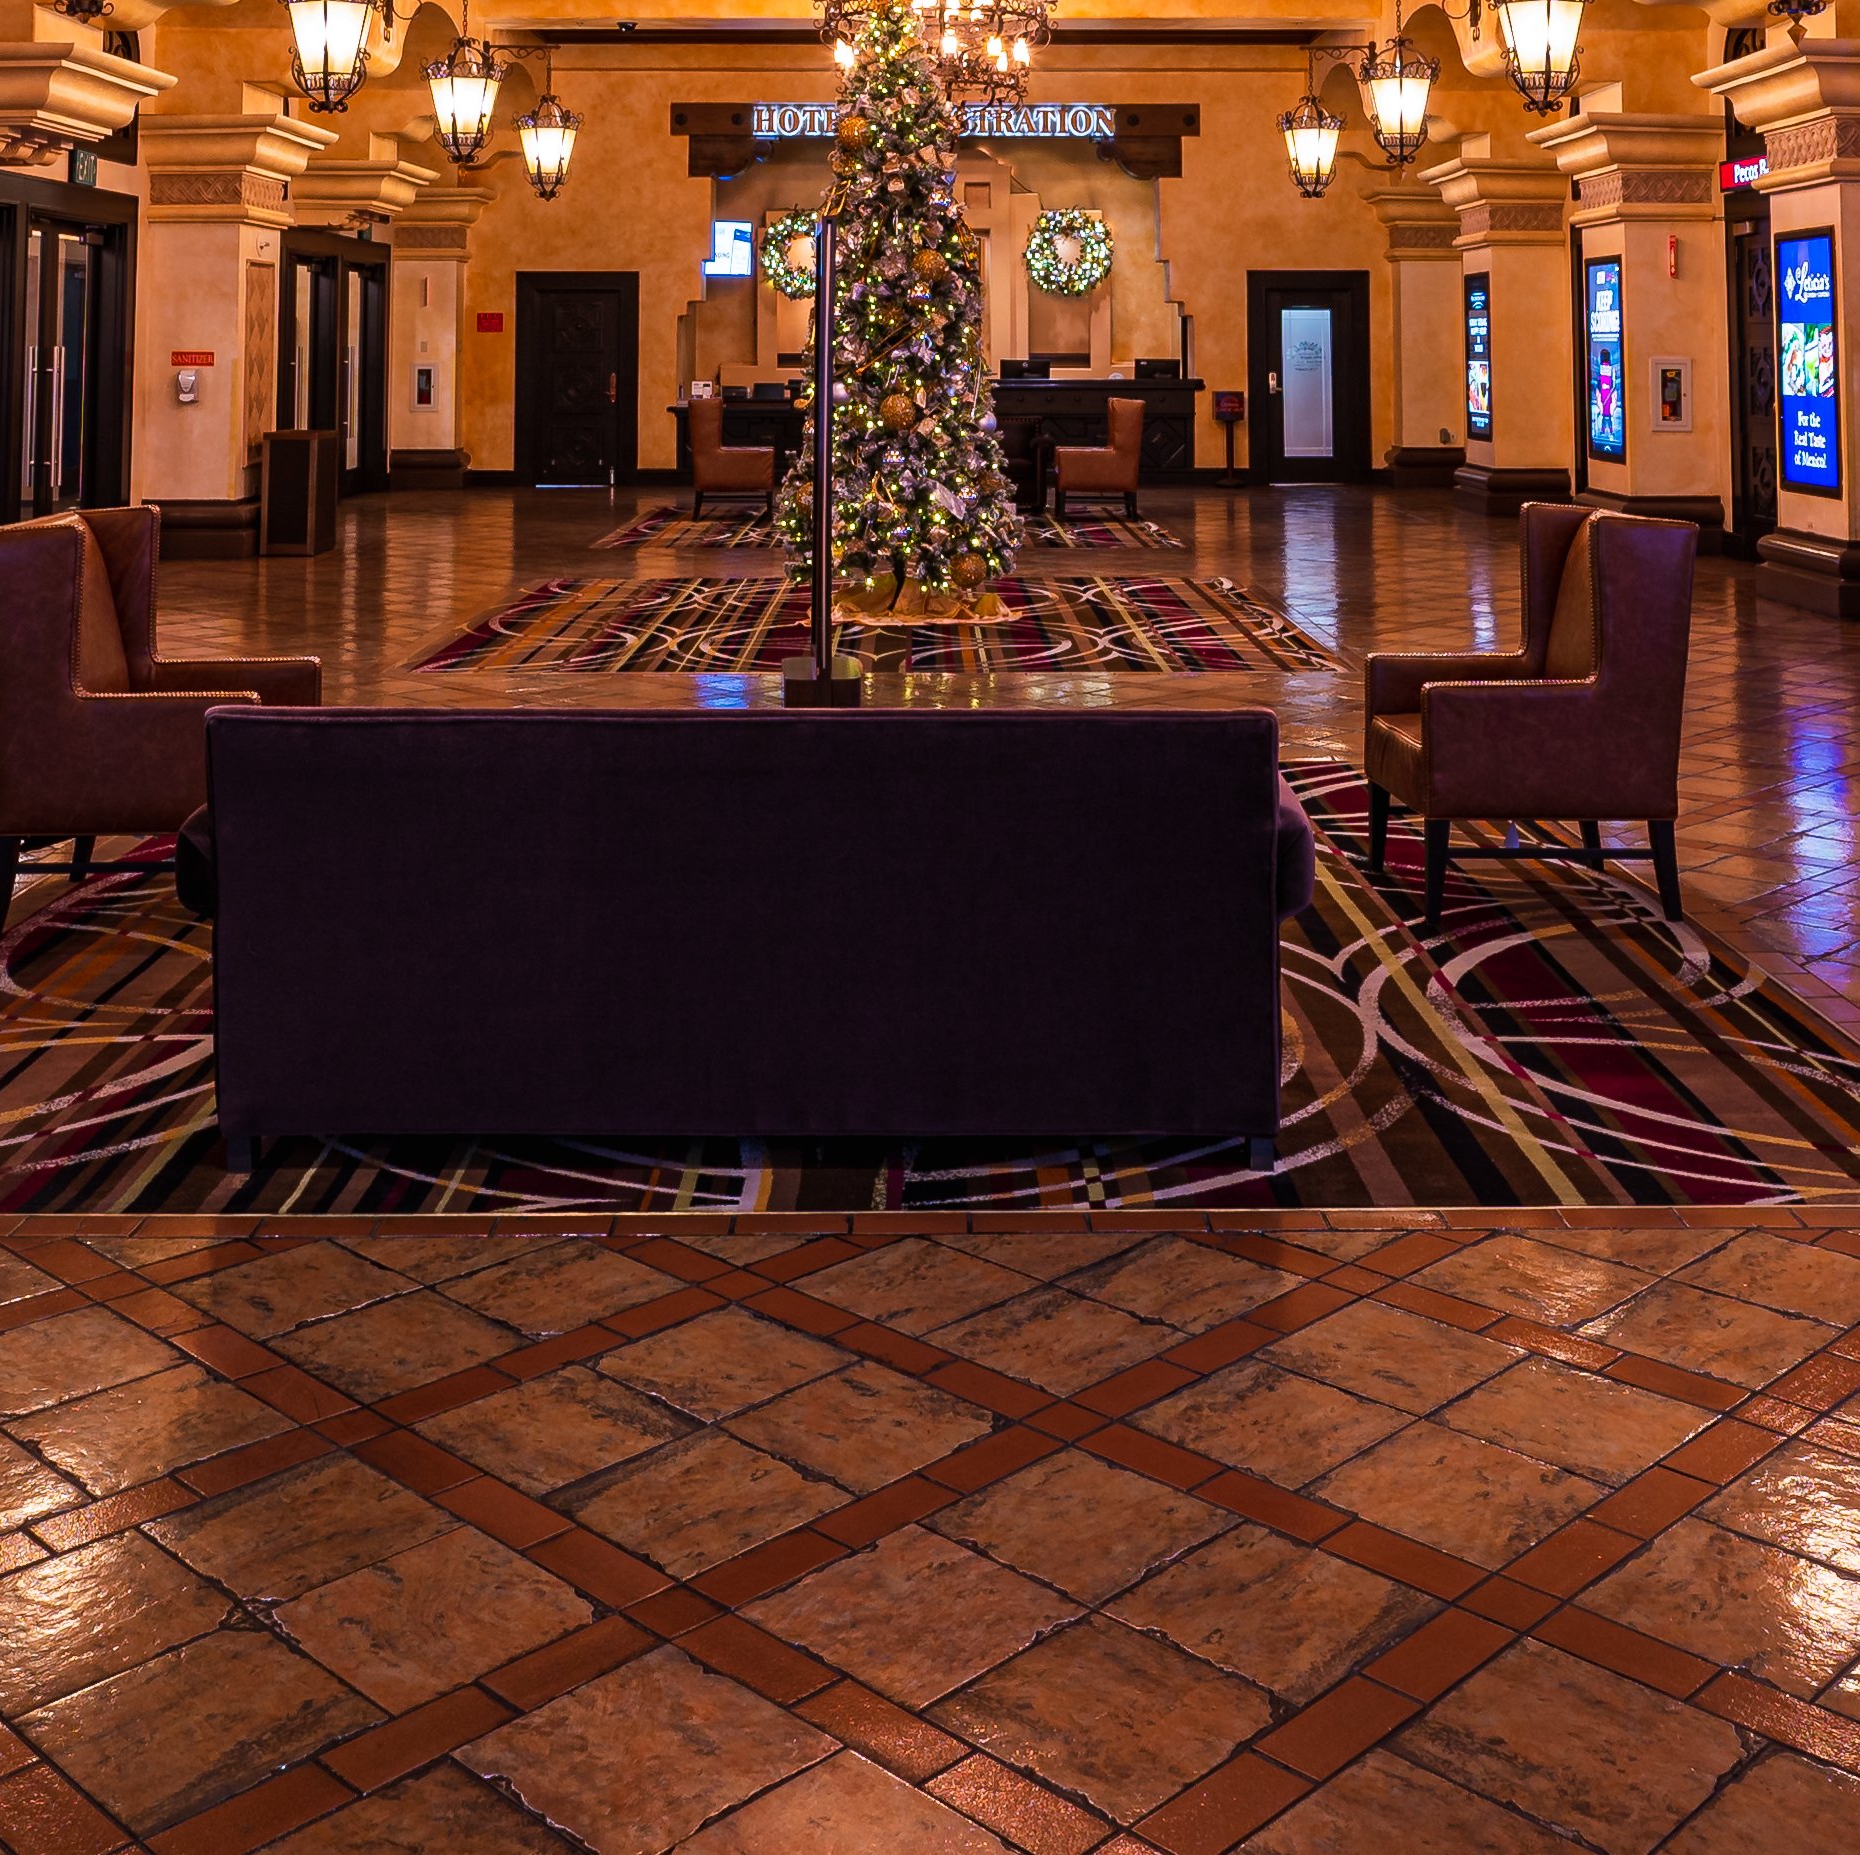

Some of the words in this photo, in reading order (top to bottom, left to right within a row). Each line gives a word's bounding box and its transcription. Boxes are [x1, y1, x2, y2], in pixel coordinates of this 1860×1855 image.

[754, 107, 839, 136] HOTE
[961, 107, 1115, 136] TRATION
[1734, 164, 1759, 184] Pecos
[172, 354, 214, 364] SANITIZER
[1798, 411, 1809, 426] For
[1809, 412, 1821, 428] the
